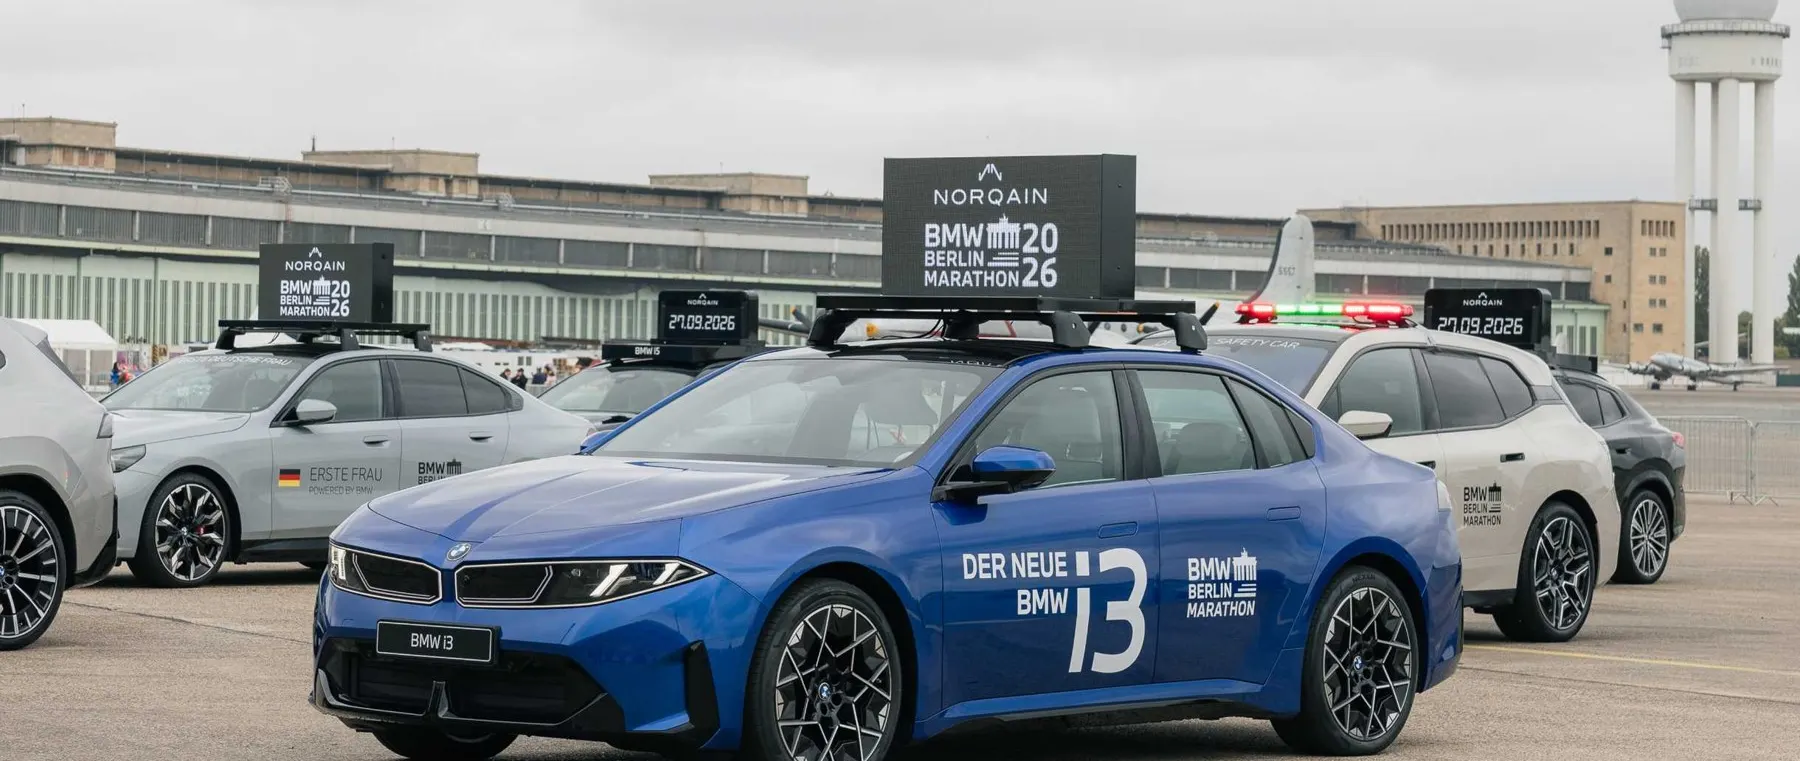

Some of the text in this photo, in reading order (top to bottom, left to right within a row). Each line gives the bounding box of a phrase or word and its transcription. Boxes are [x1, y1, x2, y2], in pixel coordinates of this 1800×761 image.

[934, 188, 1048, 206] NORQAIN
[925, 222, 1059, 254] BMW 20
[285, 261, 345, 271] NORQAIN
[924, 250, 984, 267] BERLIN
[924, 256, 1058, 288] MARATHON 26
[280, 280, 350, 298] BMW 20
[280, 295, 312, 305] BERLIN
[280, 299, 350, 317] MARATHON 26
[669, 314, 735, 330] 27.09.2026
[1438, 317, 1523, 335] 27.09.2026
[635, 346, 653, 355] BMW
[1215, 337, 1266, 346] SAFETY
[1269, 340, 1300, 349] CAR
[261, 357, 293, 366] FRAU
[310, 467, 383, 482] ERSTE FRAU
[417, 461, 446, 475] BMW
[308, 486, 373, 495] POWERED BY BMW
[1463, 486, 1488, 501] BMW
[1463, 503, 1488, 514] BERLIN
[1463, 515, 1501, 526] MARATHON
[962, 551, 1068, 580] DER NEUE
[1188, 557, 1231, 581] BMW
[1188, 582, 1232, 599] BERLIN
[1017, 588, 1068, 615] BMW
[1186, 600, 1256, 618] MARATHON
[410, 633, 454, 650] BMW i3
